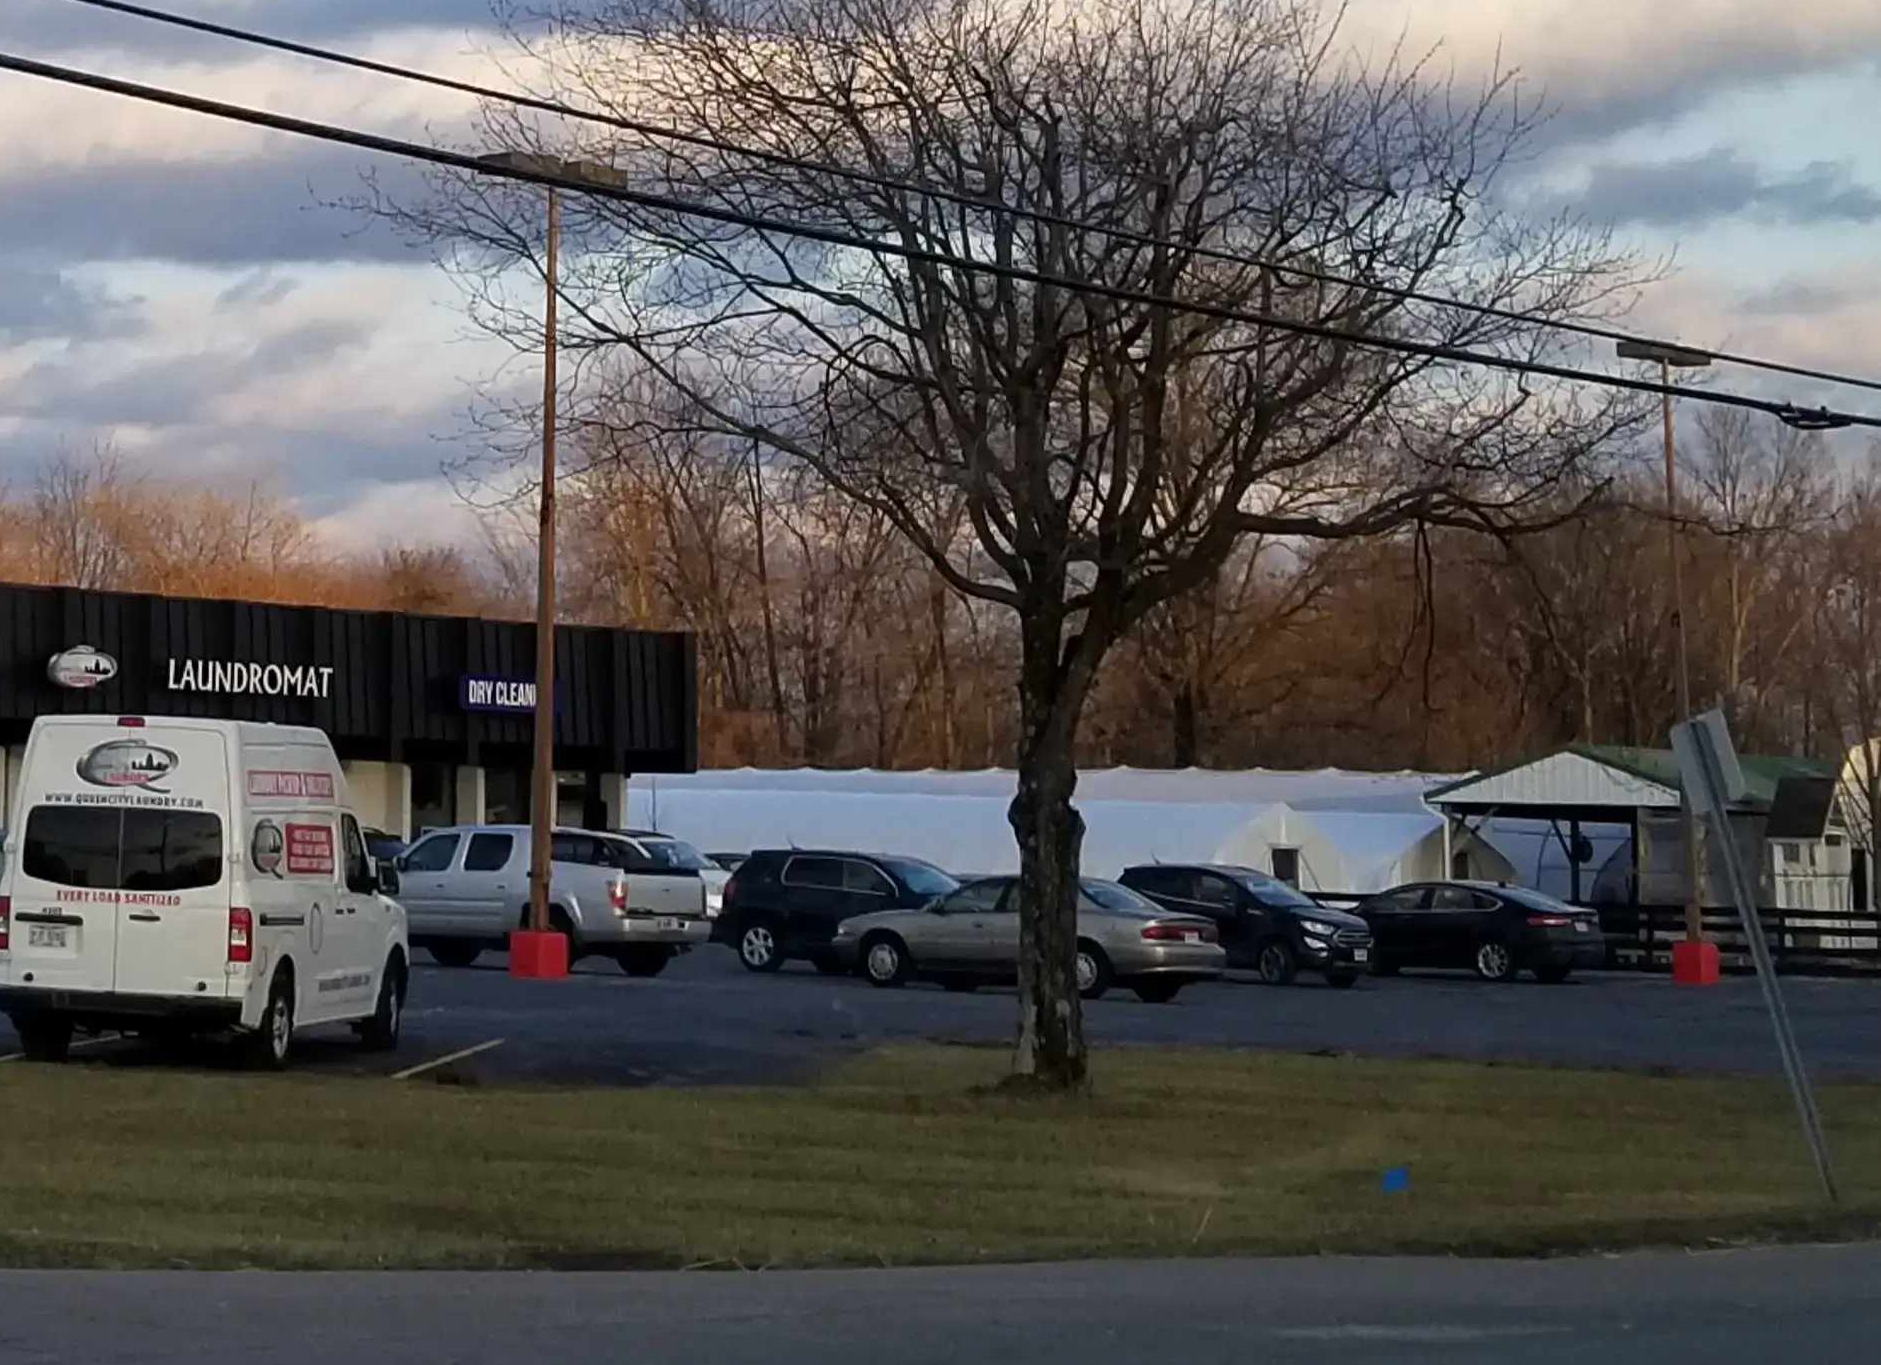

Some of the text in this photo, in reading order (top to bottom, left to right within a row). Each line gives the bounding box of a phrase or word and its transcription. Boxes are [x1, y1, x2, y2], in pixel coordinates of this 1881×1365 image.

[168, 658, 334, 698] LAUNDROMAT
[468, 679, 494, 705] DRY
[56, 889, 89, 902] EVERY
[92, 891, 121, 904] LOAD
